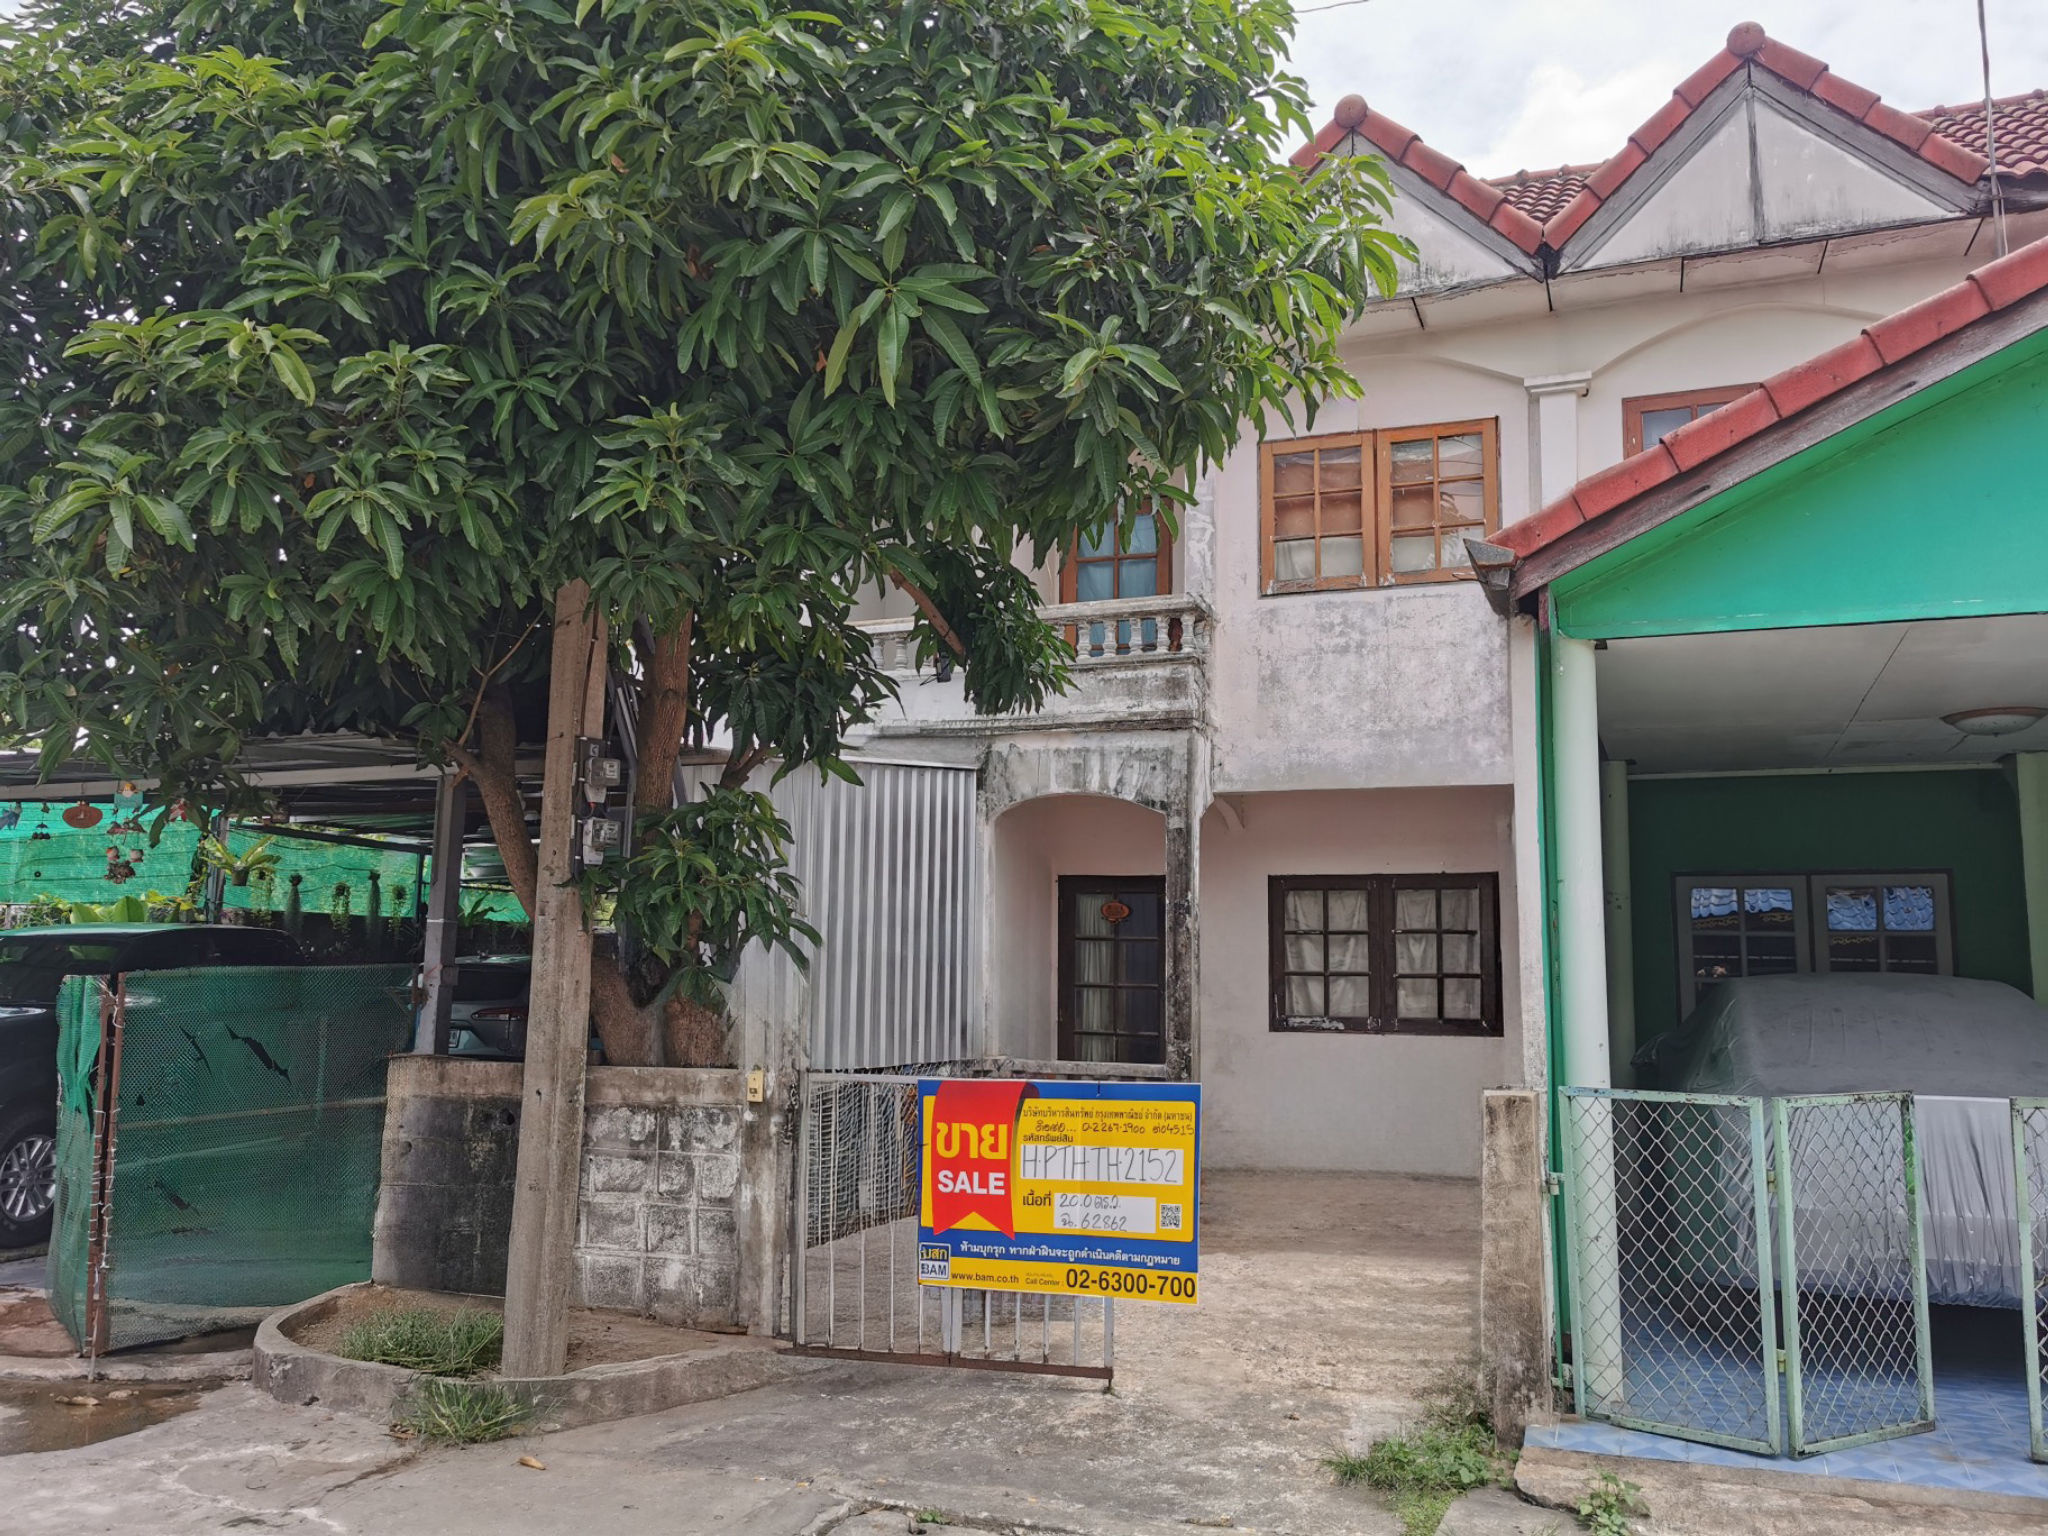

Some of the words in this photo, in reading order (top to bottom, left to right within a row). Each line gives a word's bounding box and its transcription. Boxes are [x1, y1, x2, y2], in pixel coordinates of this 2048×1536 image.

[1144, 1109, 1162, 1120] จำกัด
[1164, 1111, 1193, 1122] (มหาชน)
[936, 1122, 1008, 1160] ขาย
[1023, 1132, 1074, 1143] รหัสทรัพย์สิน
[938, 1170, 1006, 1195] SALE
[1022, 1190, 1052, 1207] เนื้อที่
[960, 1240, 1006, 1256] ห้ามบุกรุก
[921, 1264, 947, 1277] BAM
[951, 1271, 1020, 1285] www.bam.co.th
[1025, 1277, 1038, 1286] Call
[1066, 1268, 1196, 1299] 02-6300-700
